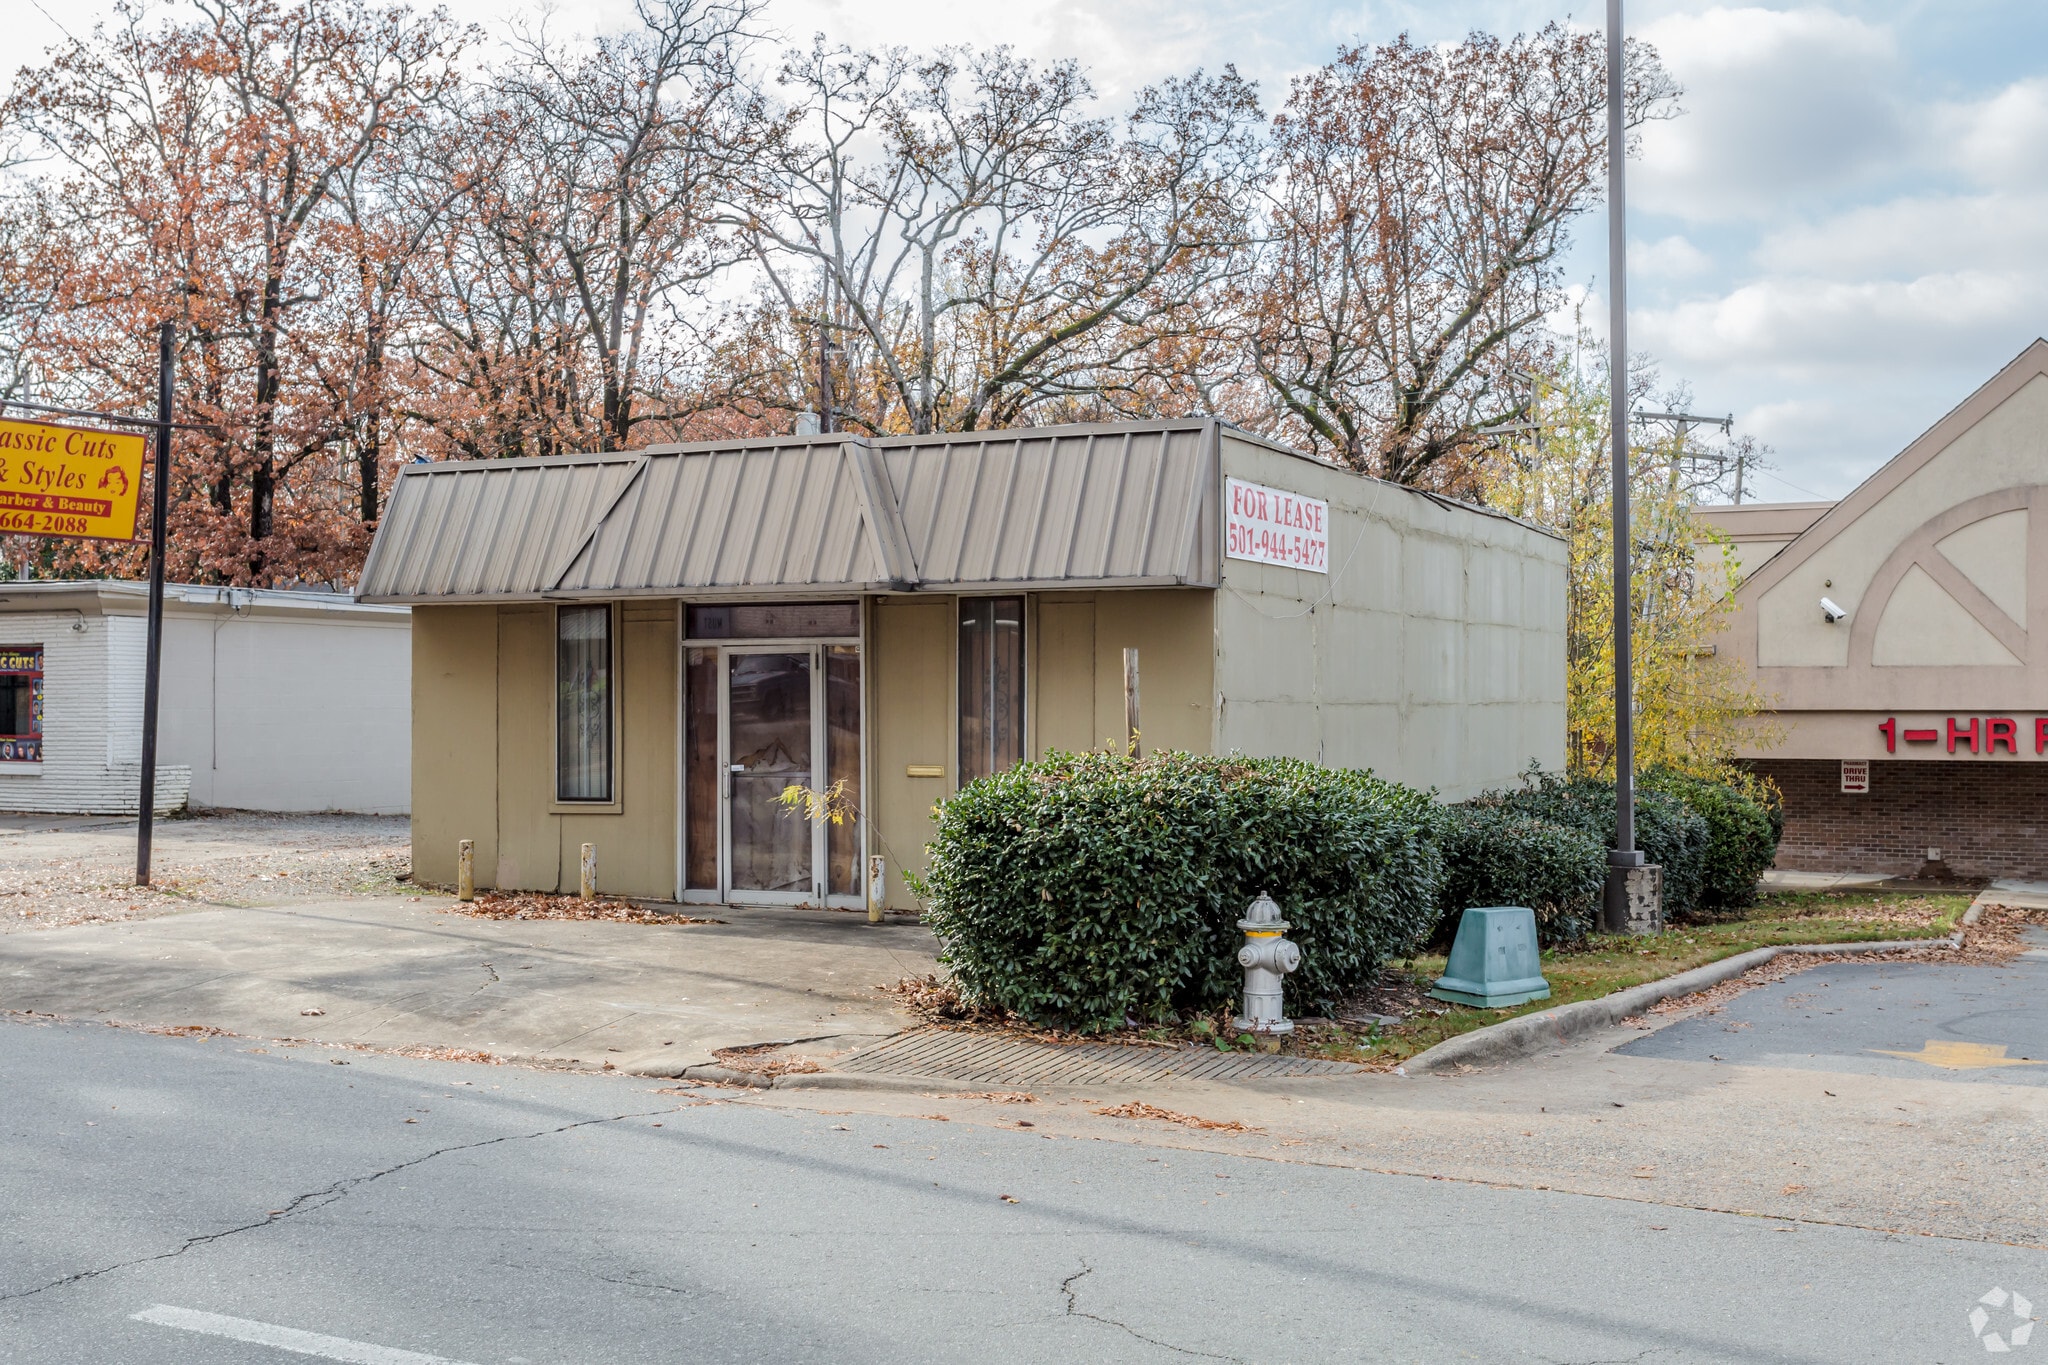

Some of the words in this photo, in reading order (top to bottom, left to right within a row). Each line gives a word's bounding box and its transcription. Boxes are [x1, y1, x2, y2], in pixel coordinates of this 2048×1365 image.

[65, 431, 117, 459] Cuts
[19, 460, 87, 492] Styles
[42, 499, 54, 509] &
[58, 500, 106, 514] Beauty
[1233, 485, 1268, 521] FOR
[1274, 495, 1322, 533] LEASE
[0, 512, 88, 533] 664-2088
[1229, 522, 1325, 567] 501-944-5477
[9, 656, 35, 669] CUTS
[1878, 717, 2018, 754] 1-HR
[1843, 767, 1867, 775] DRIVE
[1845, 775, 1866, 783] THRU
